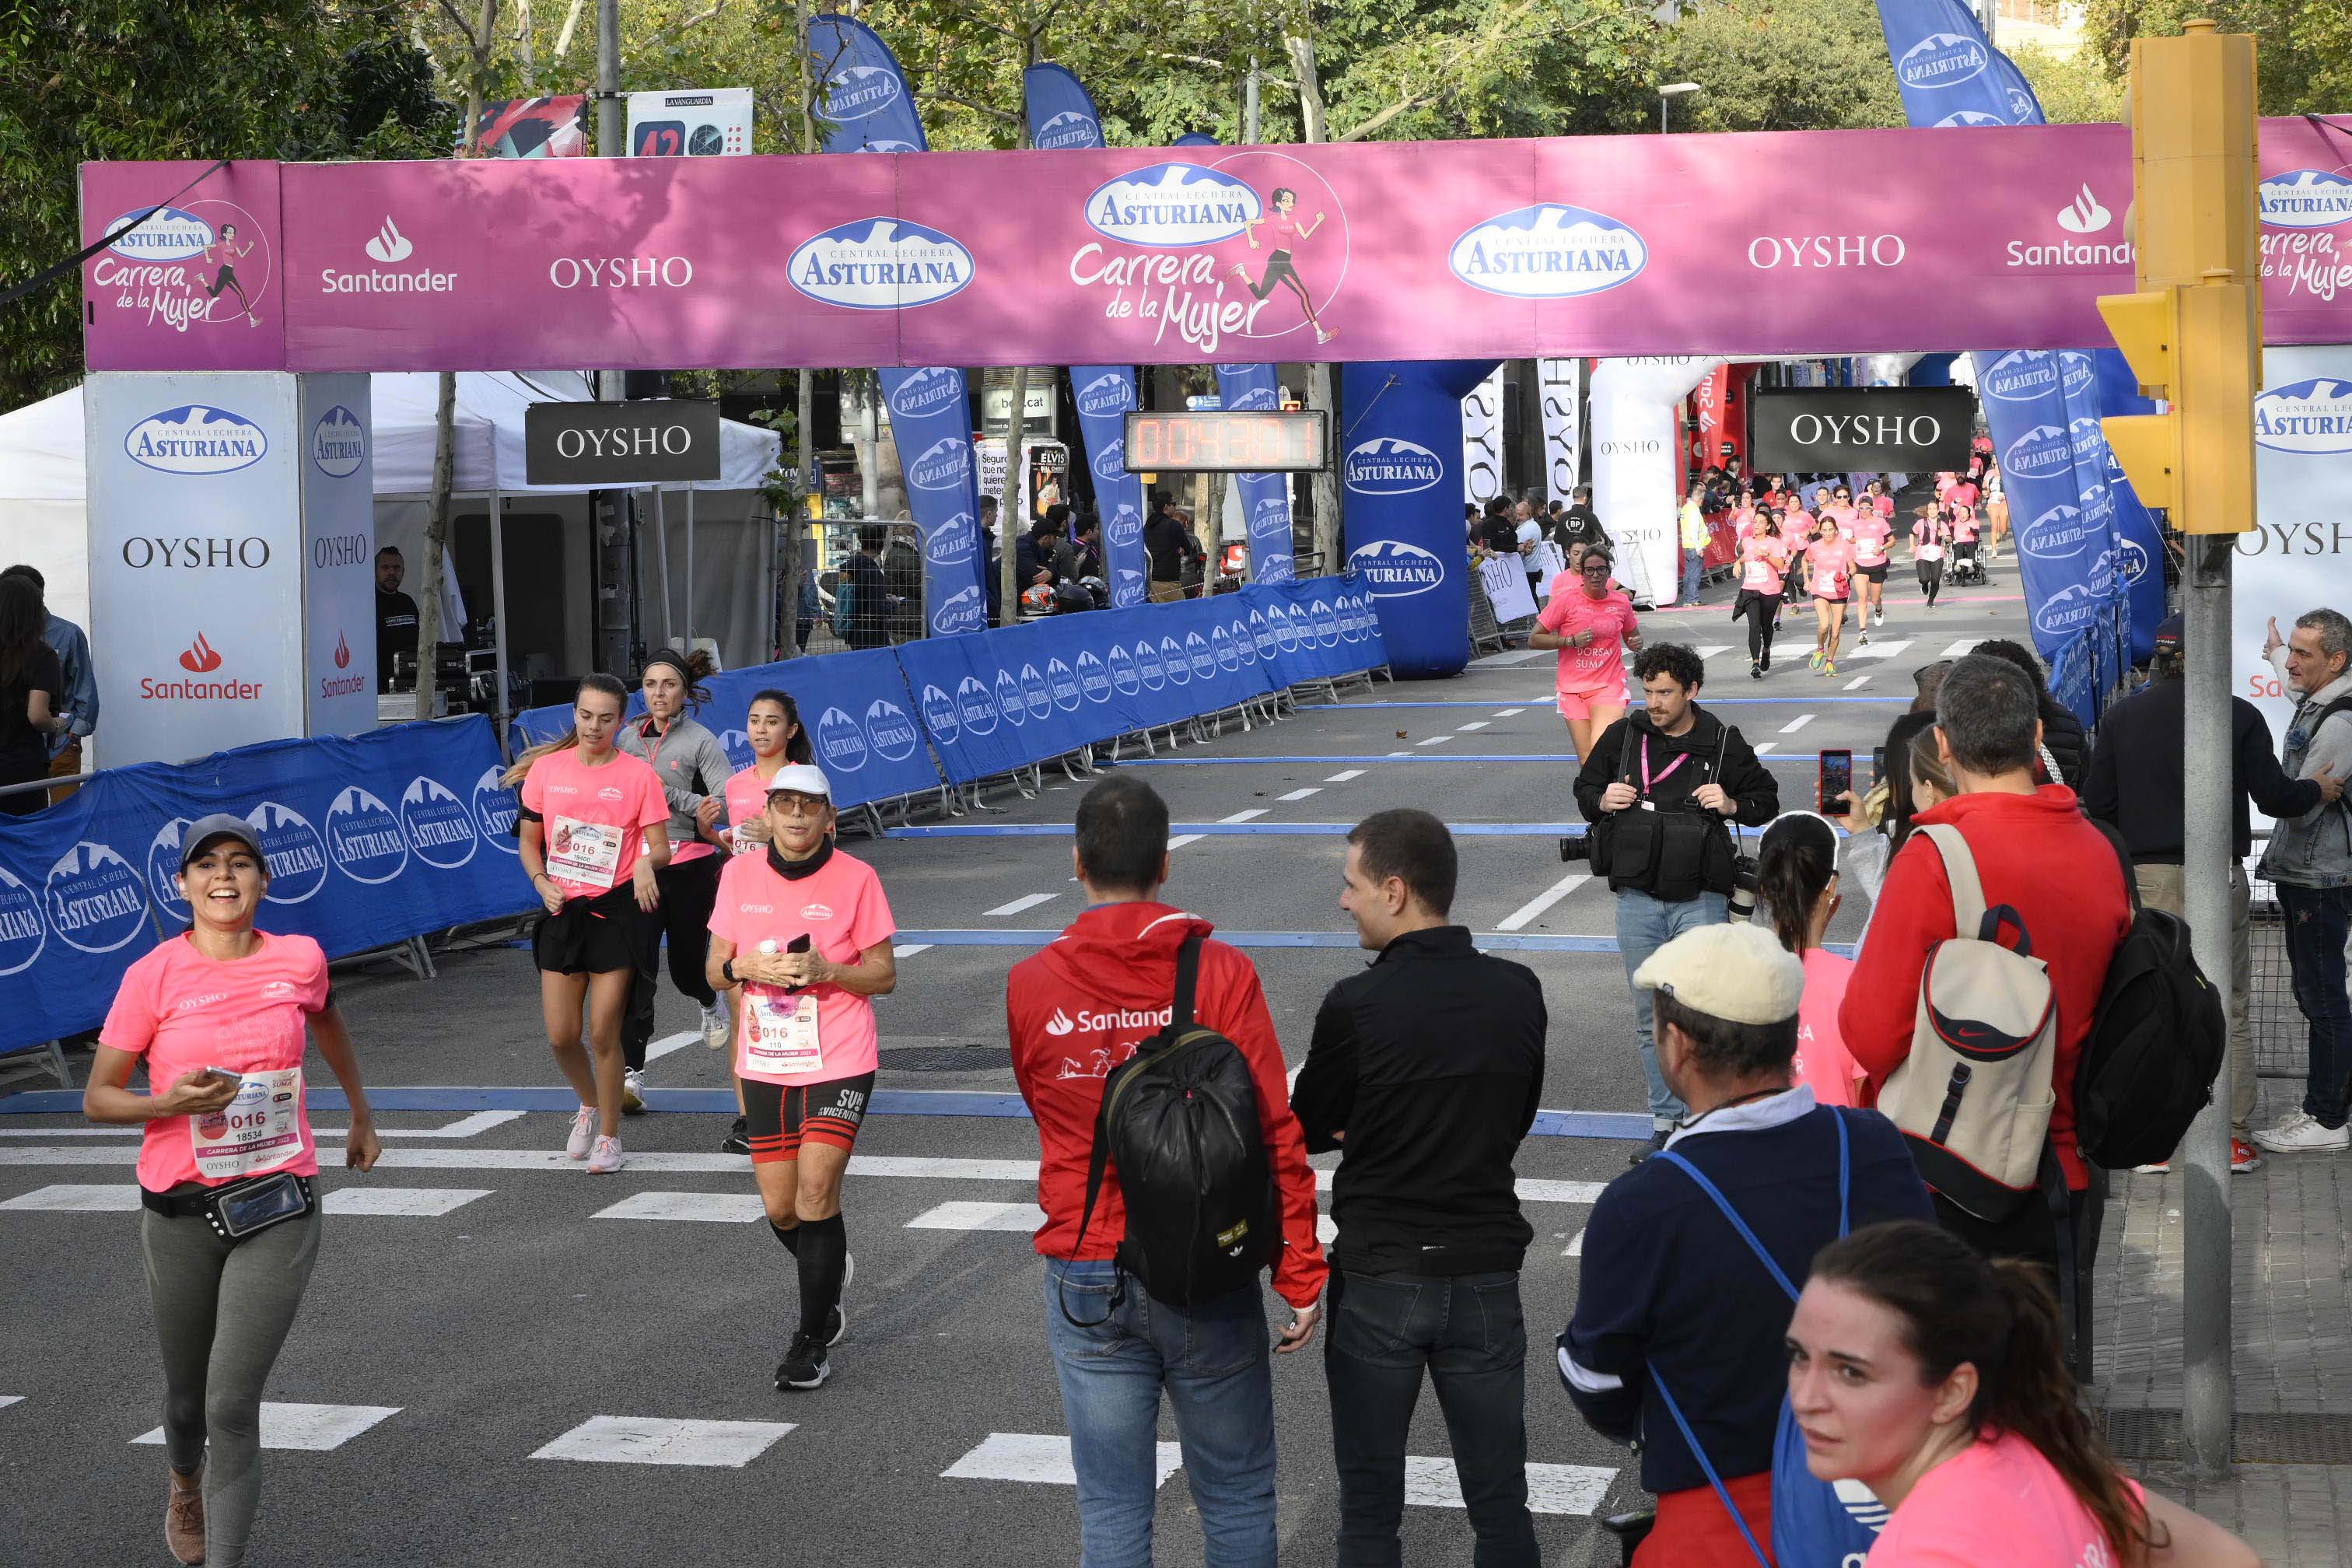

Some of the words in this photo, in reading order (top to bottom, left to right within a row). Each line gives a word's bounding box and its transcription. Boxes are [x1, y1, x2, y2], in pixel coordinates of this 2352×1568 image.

[1125, 191, 1180, 201] CENTRAL
[1186, 191, 1243, 199] LECHERA
[2271, 187, 2311, 196] CENTRAL
[2315, 186, 2352, 195] LECHER
[1099, 194, 1248, 226] ASTURIANA
[112, 226, 206, 247] ASTURIANA
[2259, 233, 2334, 254] arrera
[831, 249, 888, 258] CENTRAL
[896, 248, 954, 257] LECHERA
[1465, 240, 1631, 275] ASTURIANA
[1748, 234, 1906, 269] OYSHO
[2007, 240, 2137, 266] Santand
[94, 258, 184, 286] Carrera
[549, 256, 693, 289] OYSHO
[801, 252, 960, 286] ASTURIANA
[1070, 243, 1215, 285] Carrera
[322, 268, 457, 293] Santander
[2278, 255, 2292, 277] la
[2288, 251, 2352, 301] Muje
[117, 288, 134, 308] de
[138, 288, 149, 307] la
[148, 285, 220, 332] Mujer
[1106, 287, 1132, 318] de
[1139, 287, 1157, 318] la
[1154, 281, 1269, 354] Mujer
[2277, 404, 2329, 413] CENTRAL
[1790, 414, 1941, 446] OYSHO
[135, 431, 257, 457] ASTURIANA
[317, 438, 362, 460] ASTURIANA
[556, 425, 691, 459] OYSHO
[1601, 439, 1660, 456] OYSHO
[1041, 453, 1064, 463] ELVIS
[983, 476, 1005, 485] quiere
[1348, 460, 1436, 482] ASTURIANA
[2235, 522, 2352, 556] OYSH
[122, 537, 270, 569] OYSHO
[314, 534, 366, 569] OYSHO
[1576, 660, 1605, 668] SUMA
[141, 678, 263, 700] Santander
[321, 674, 365, 698] Santander
[823, 733, 865, 758] ASTURIANA
[341, 821, 366, 832] CENTRAL
[408, 814, 474, 849] ASTURIANA
[260, 838, 282, 850] ENTRAL
[334, 826, 404, 864] ASTURIANA
[573, 843, 595, 854] 016
[735, 840, 756, 851] 016
[63, 879, 95, 894] CENTRAL
[741, 903, 772, 914] OYSHO
[179, 992, 228, 1010] OYSHO
[1077, 1007, 1173, 1033] Santand
[763, 1027, 788, 1038] 016
[231, 1111, 266, 1129] 016
[236, 1130, 262, 1142] 18534
[207, 1146, 238, 1155] CARRERA
[206, 1160, 240, 1170] OYSHO
